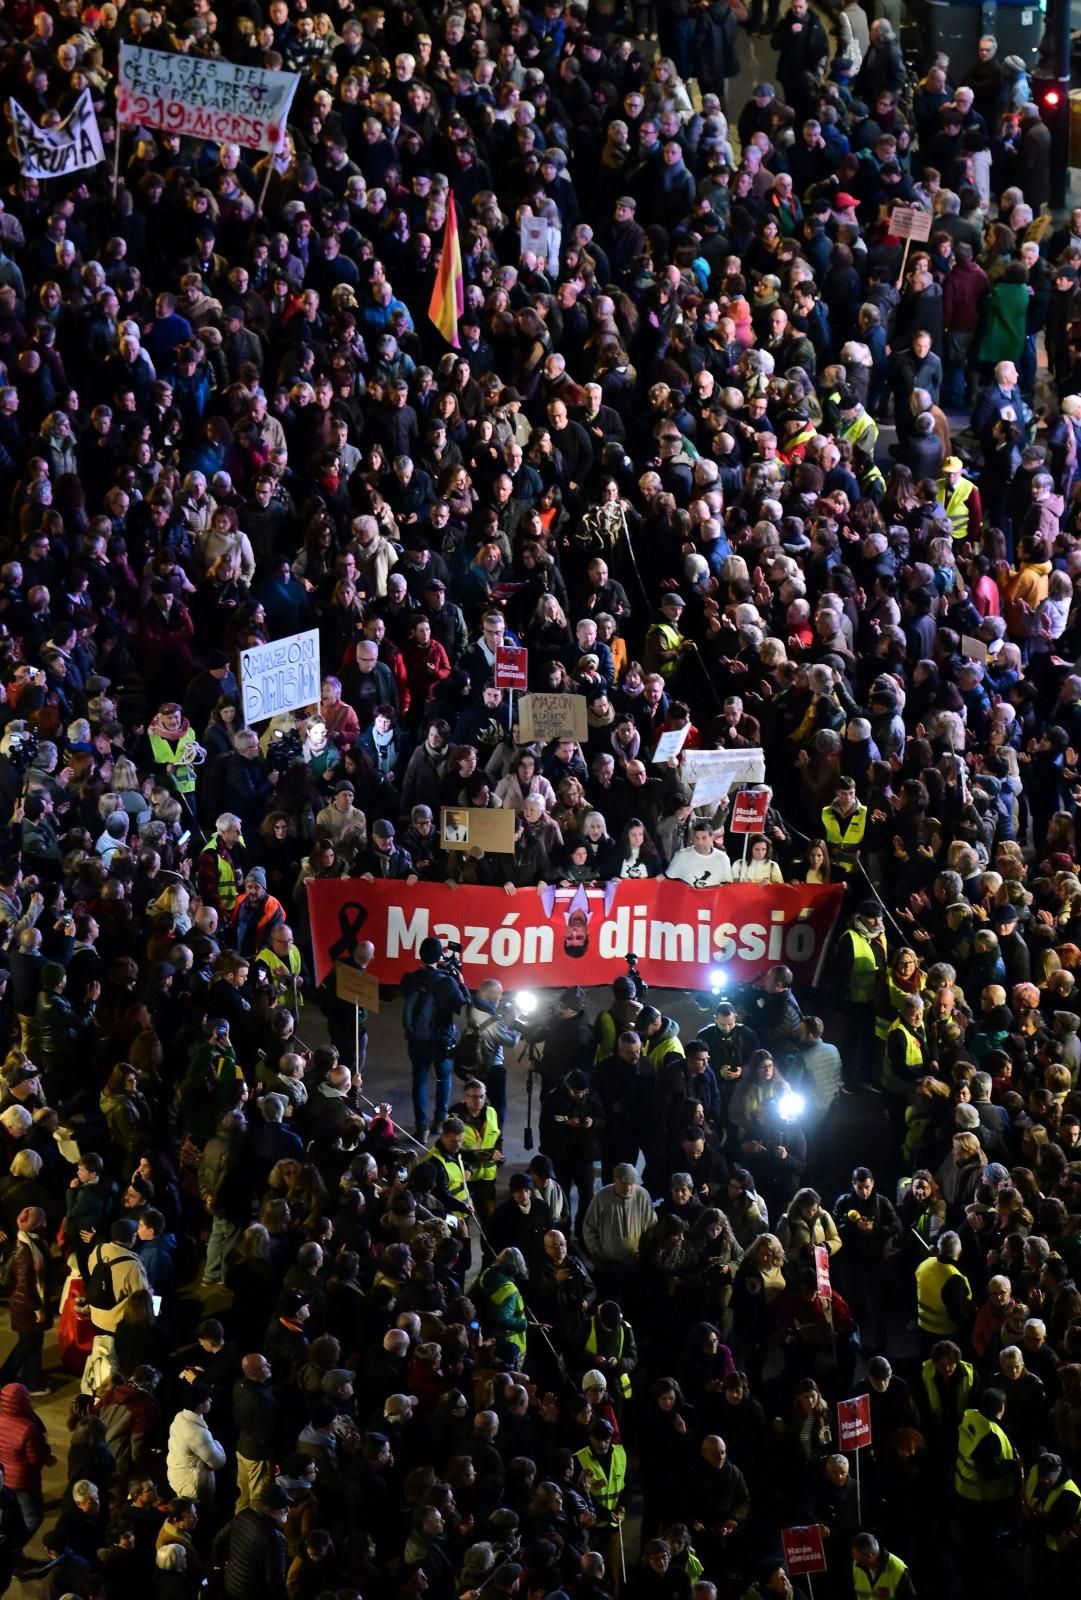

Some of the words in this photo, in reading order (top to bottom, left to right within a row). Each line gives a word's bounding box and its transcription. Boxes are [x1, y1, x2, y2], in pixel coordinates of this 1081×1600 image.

[132, 48, 218, 78] JUTGES
[235, 66, 269, 88] DEL
[132, 79, 161, 98] PER
[193, 113, 265, 144] MORTS
[386, 905, 555, 967] Mazón
[599, 905, 816, 964] dimissió
